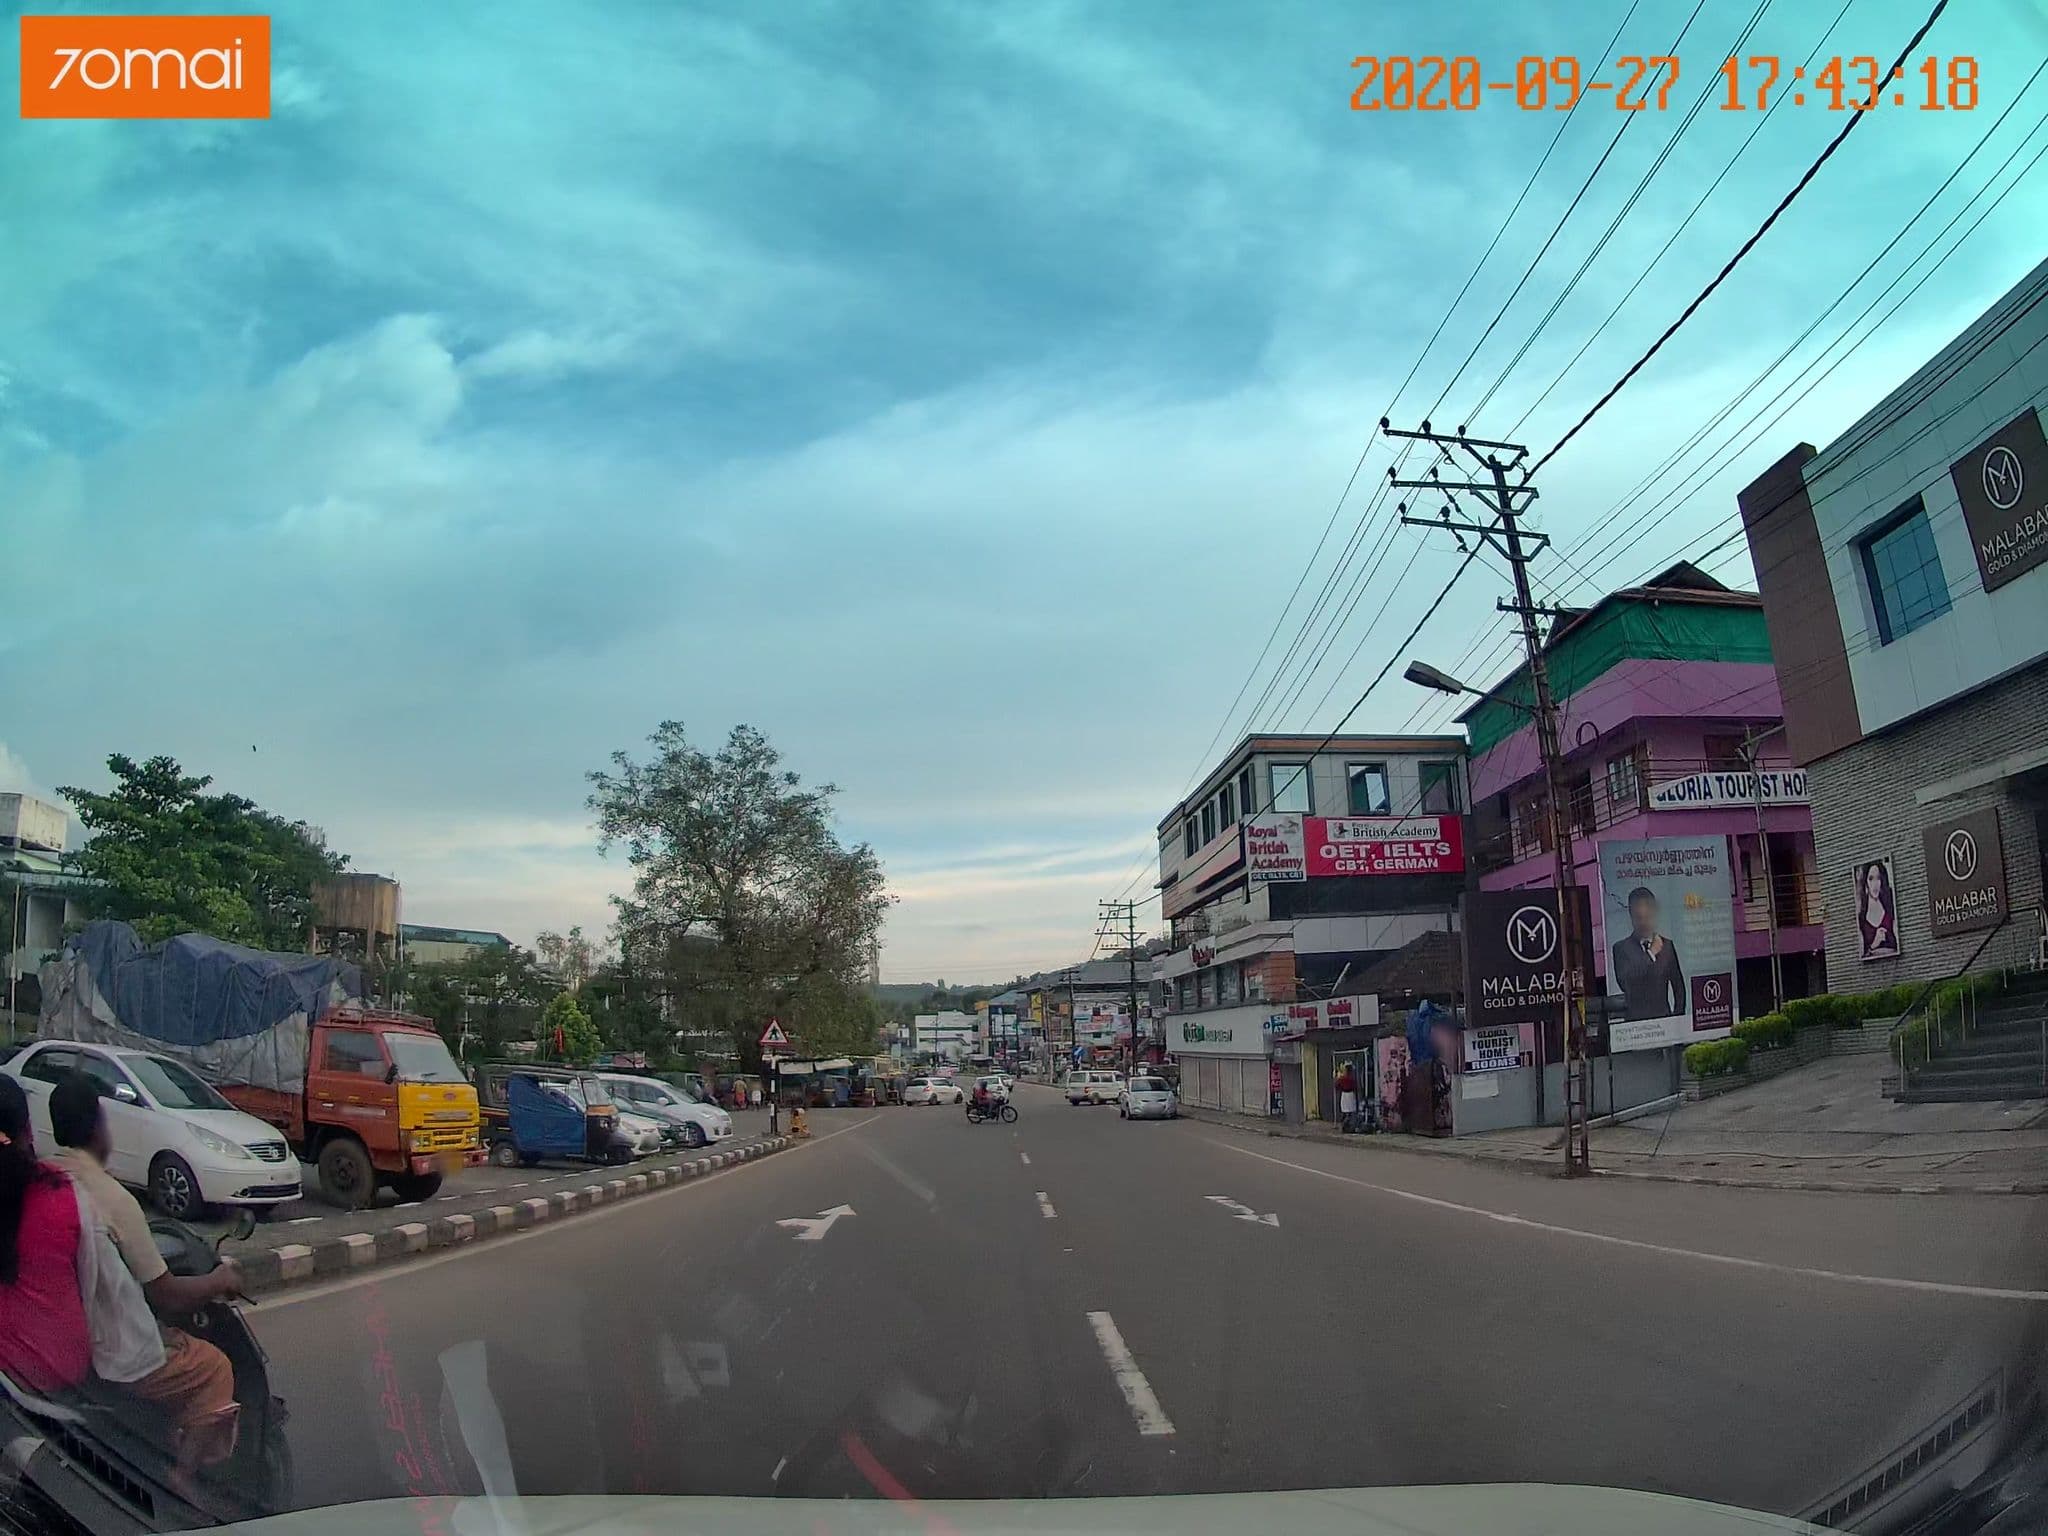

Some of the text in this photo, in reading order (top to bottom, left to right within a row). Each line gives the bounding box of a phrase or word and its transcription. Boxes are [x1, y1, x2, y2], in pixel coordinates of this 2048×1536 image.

[1987, 554, 2011, 574] GOLD
[1248, 825, 1278, 839] Royal
[1353, 825, 1438, 837] British Academy
[1248, 841, 1289, 855] British
[1319, 841, 1451, 859] OET, IELTS
[1251, 856, 1303, 870] Academy
[1373, 857, 1439, 870] GERMAN
[1934, 886, 1997, 915] MALABAR
[1484, 997, 1516, 1009] GOLD
[1518, 996, 1526, 1006] &
[1477, 1029, 1508, 1038] GLORIA
[1472, 1037, 1515, 1050] TOURIST
[1479, 1048, 1508, 1059] HOME
[1471, 1057, 1516, 1070] ROOMS
